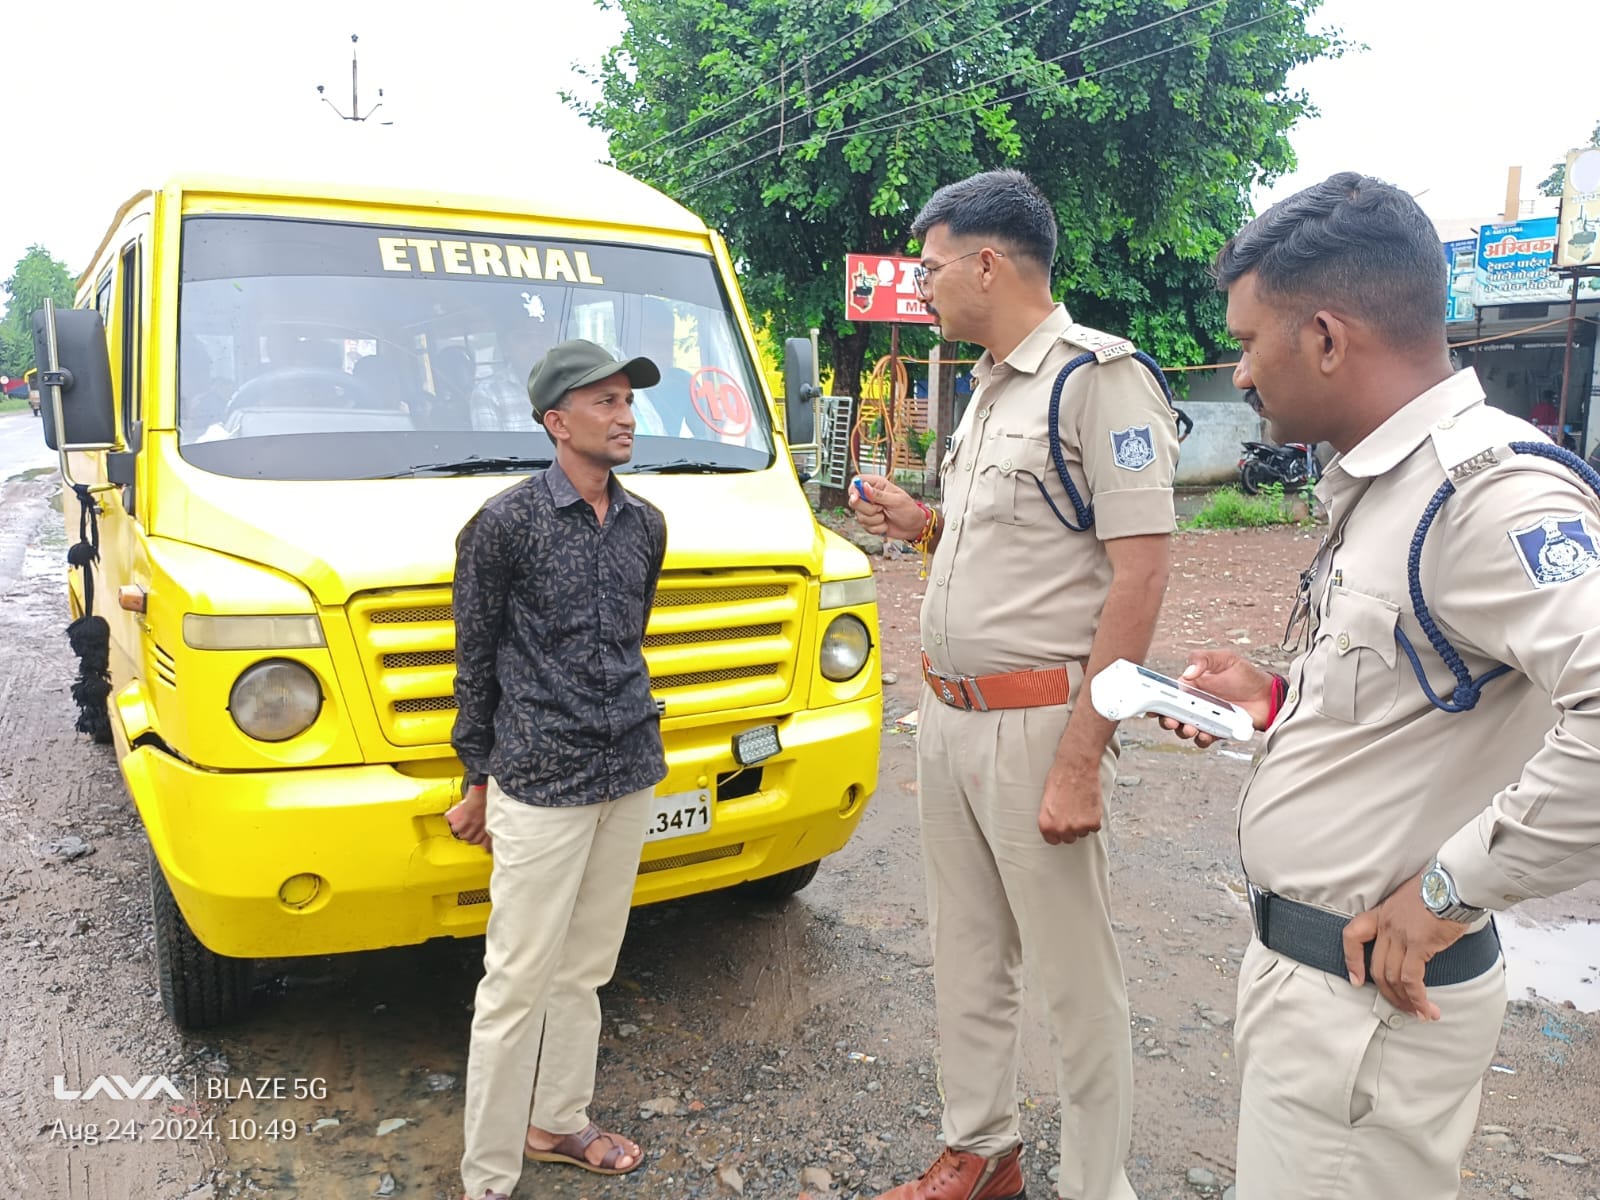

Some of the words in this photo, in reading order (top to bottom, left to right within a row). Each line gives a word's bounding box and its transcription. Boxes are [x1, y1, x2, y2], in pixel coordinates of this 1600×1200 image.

[377, 237, 604, 285] ETERNAL
[1485, 235, 1554, 257] अम्बिक
[697, 380, 746, 425] 10
[646, 805, 709, 835] .3471
